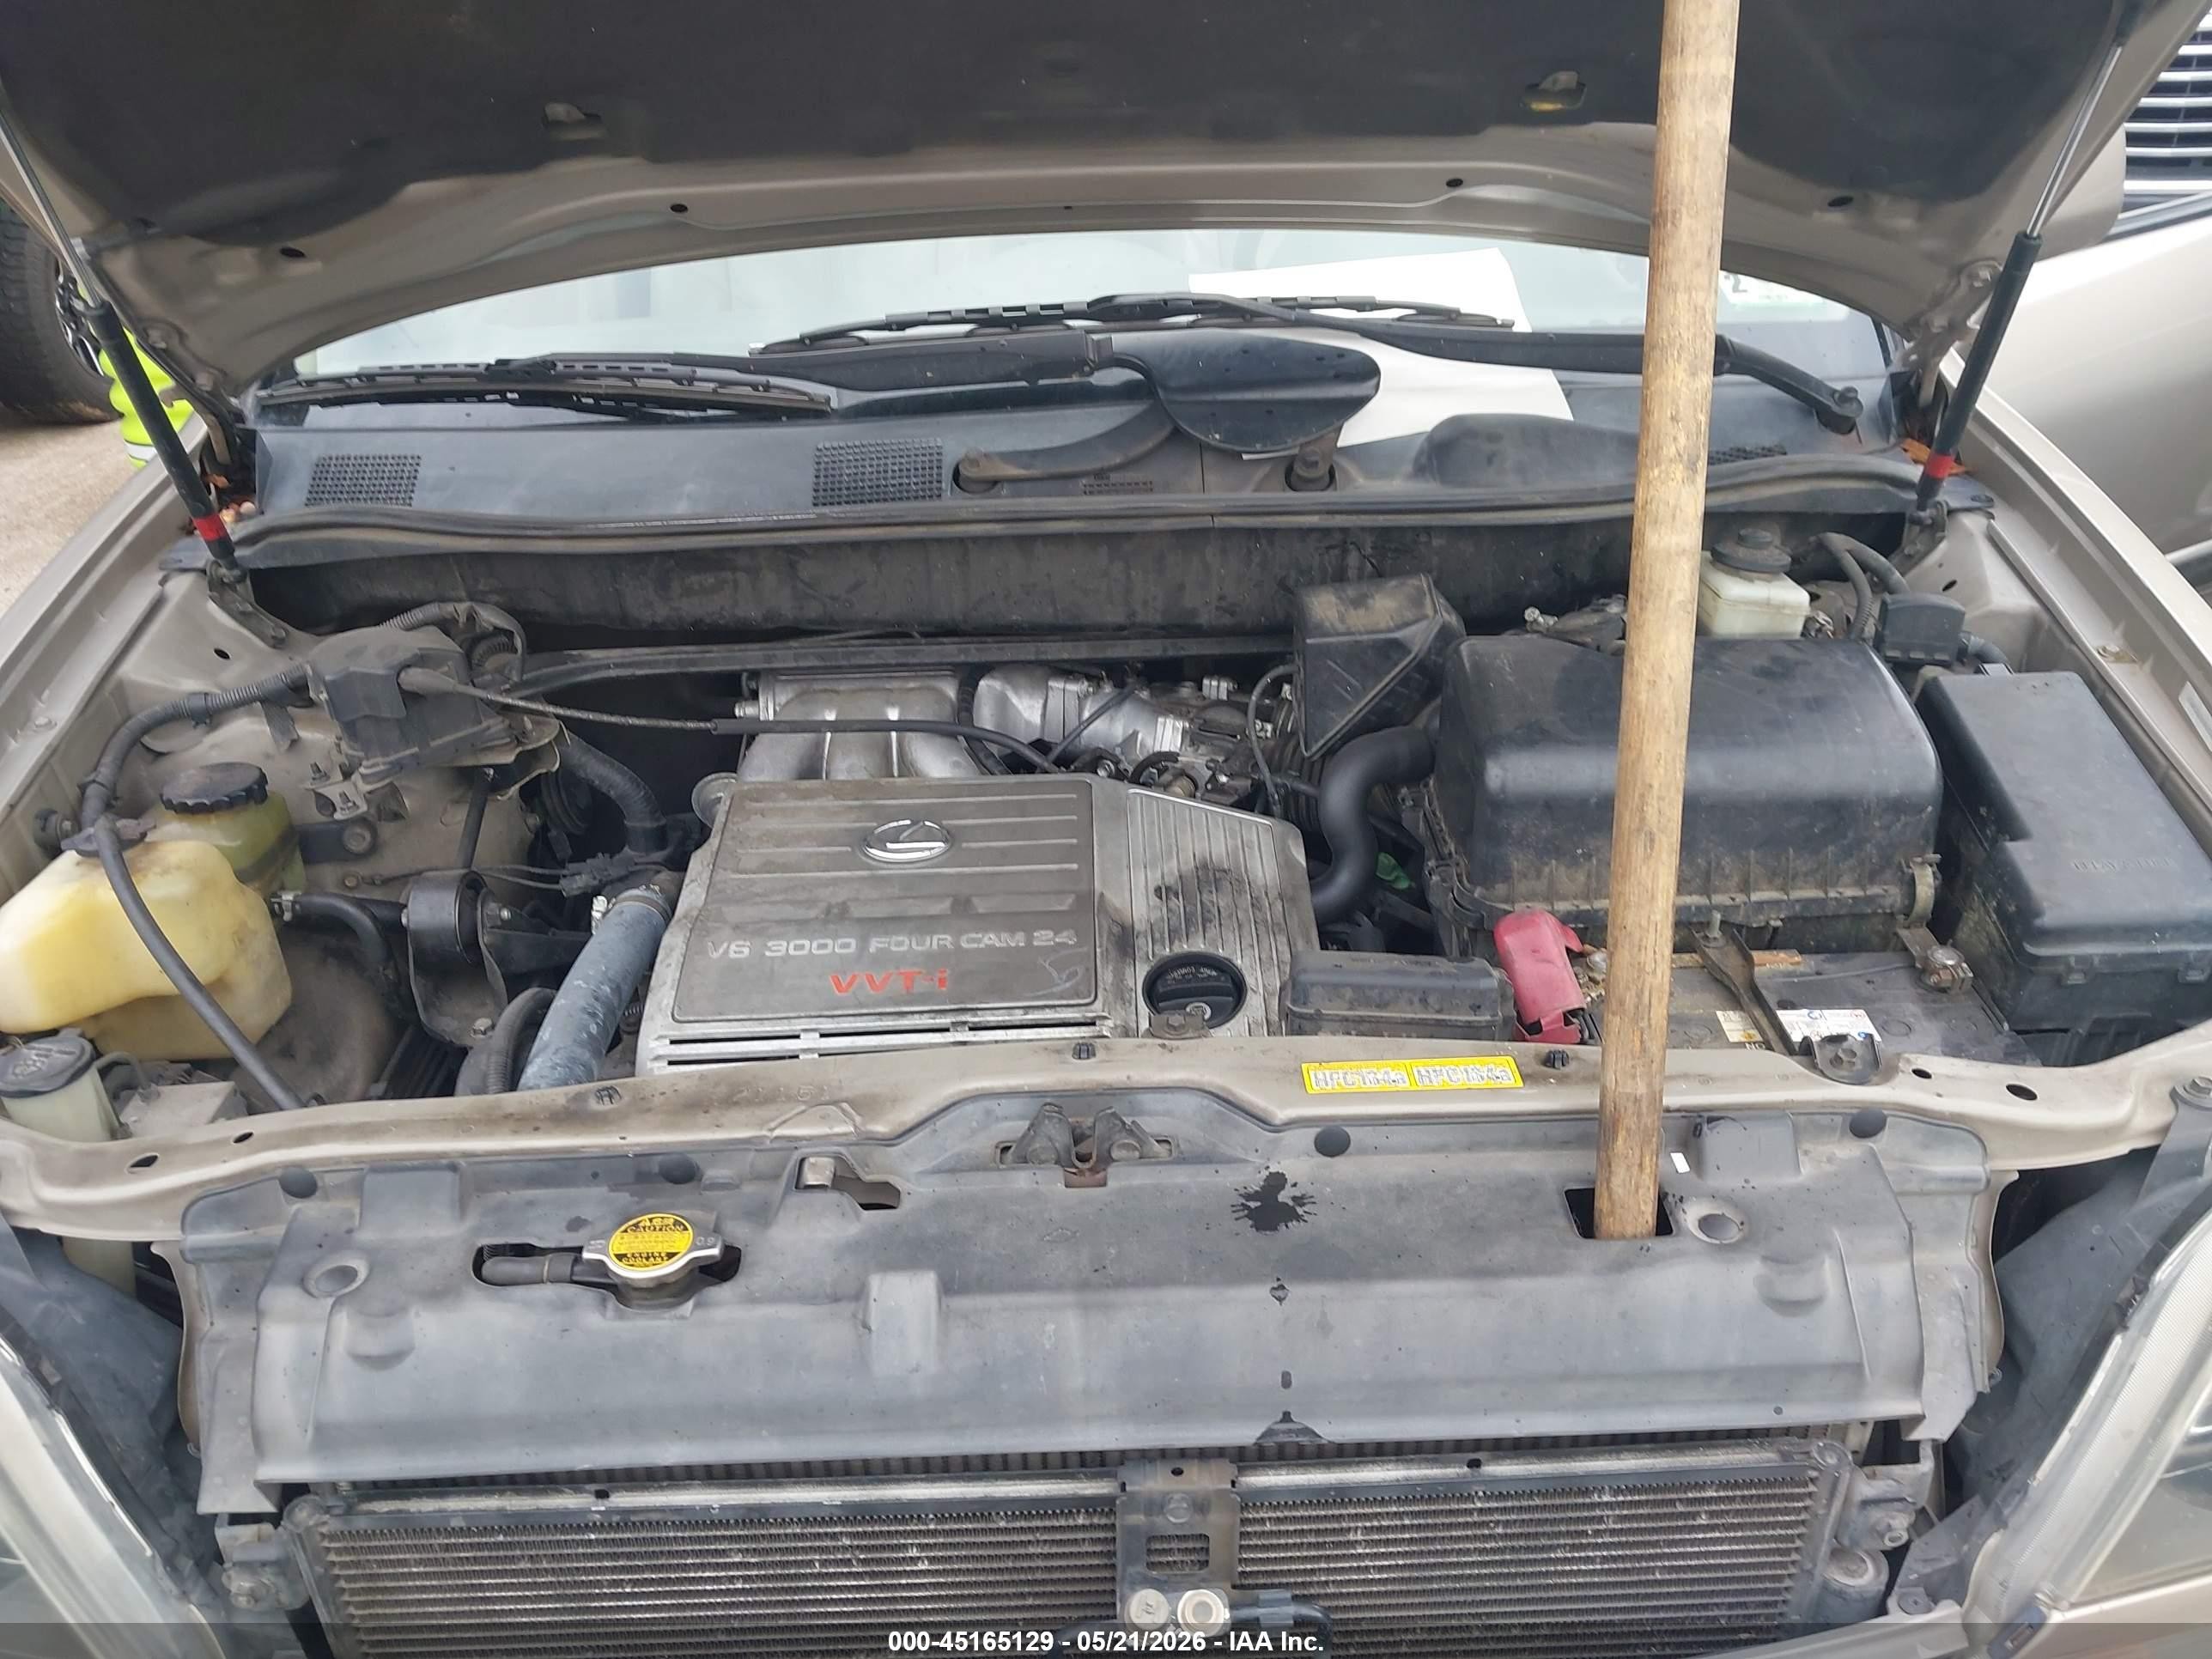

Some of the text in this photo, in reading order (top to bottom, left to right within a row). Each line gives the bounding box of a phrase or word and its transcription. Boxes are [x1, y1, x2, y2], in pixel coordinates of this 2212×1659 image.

[708, 930, 1079, 958] V6 3000 FOUR CAM 24
[830, 968, 949, 996] VVT-i
